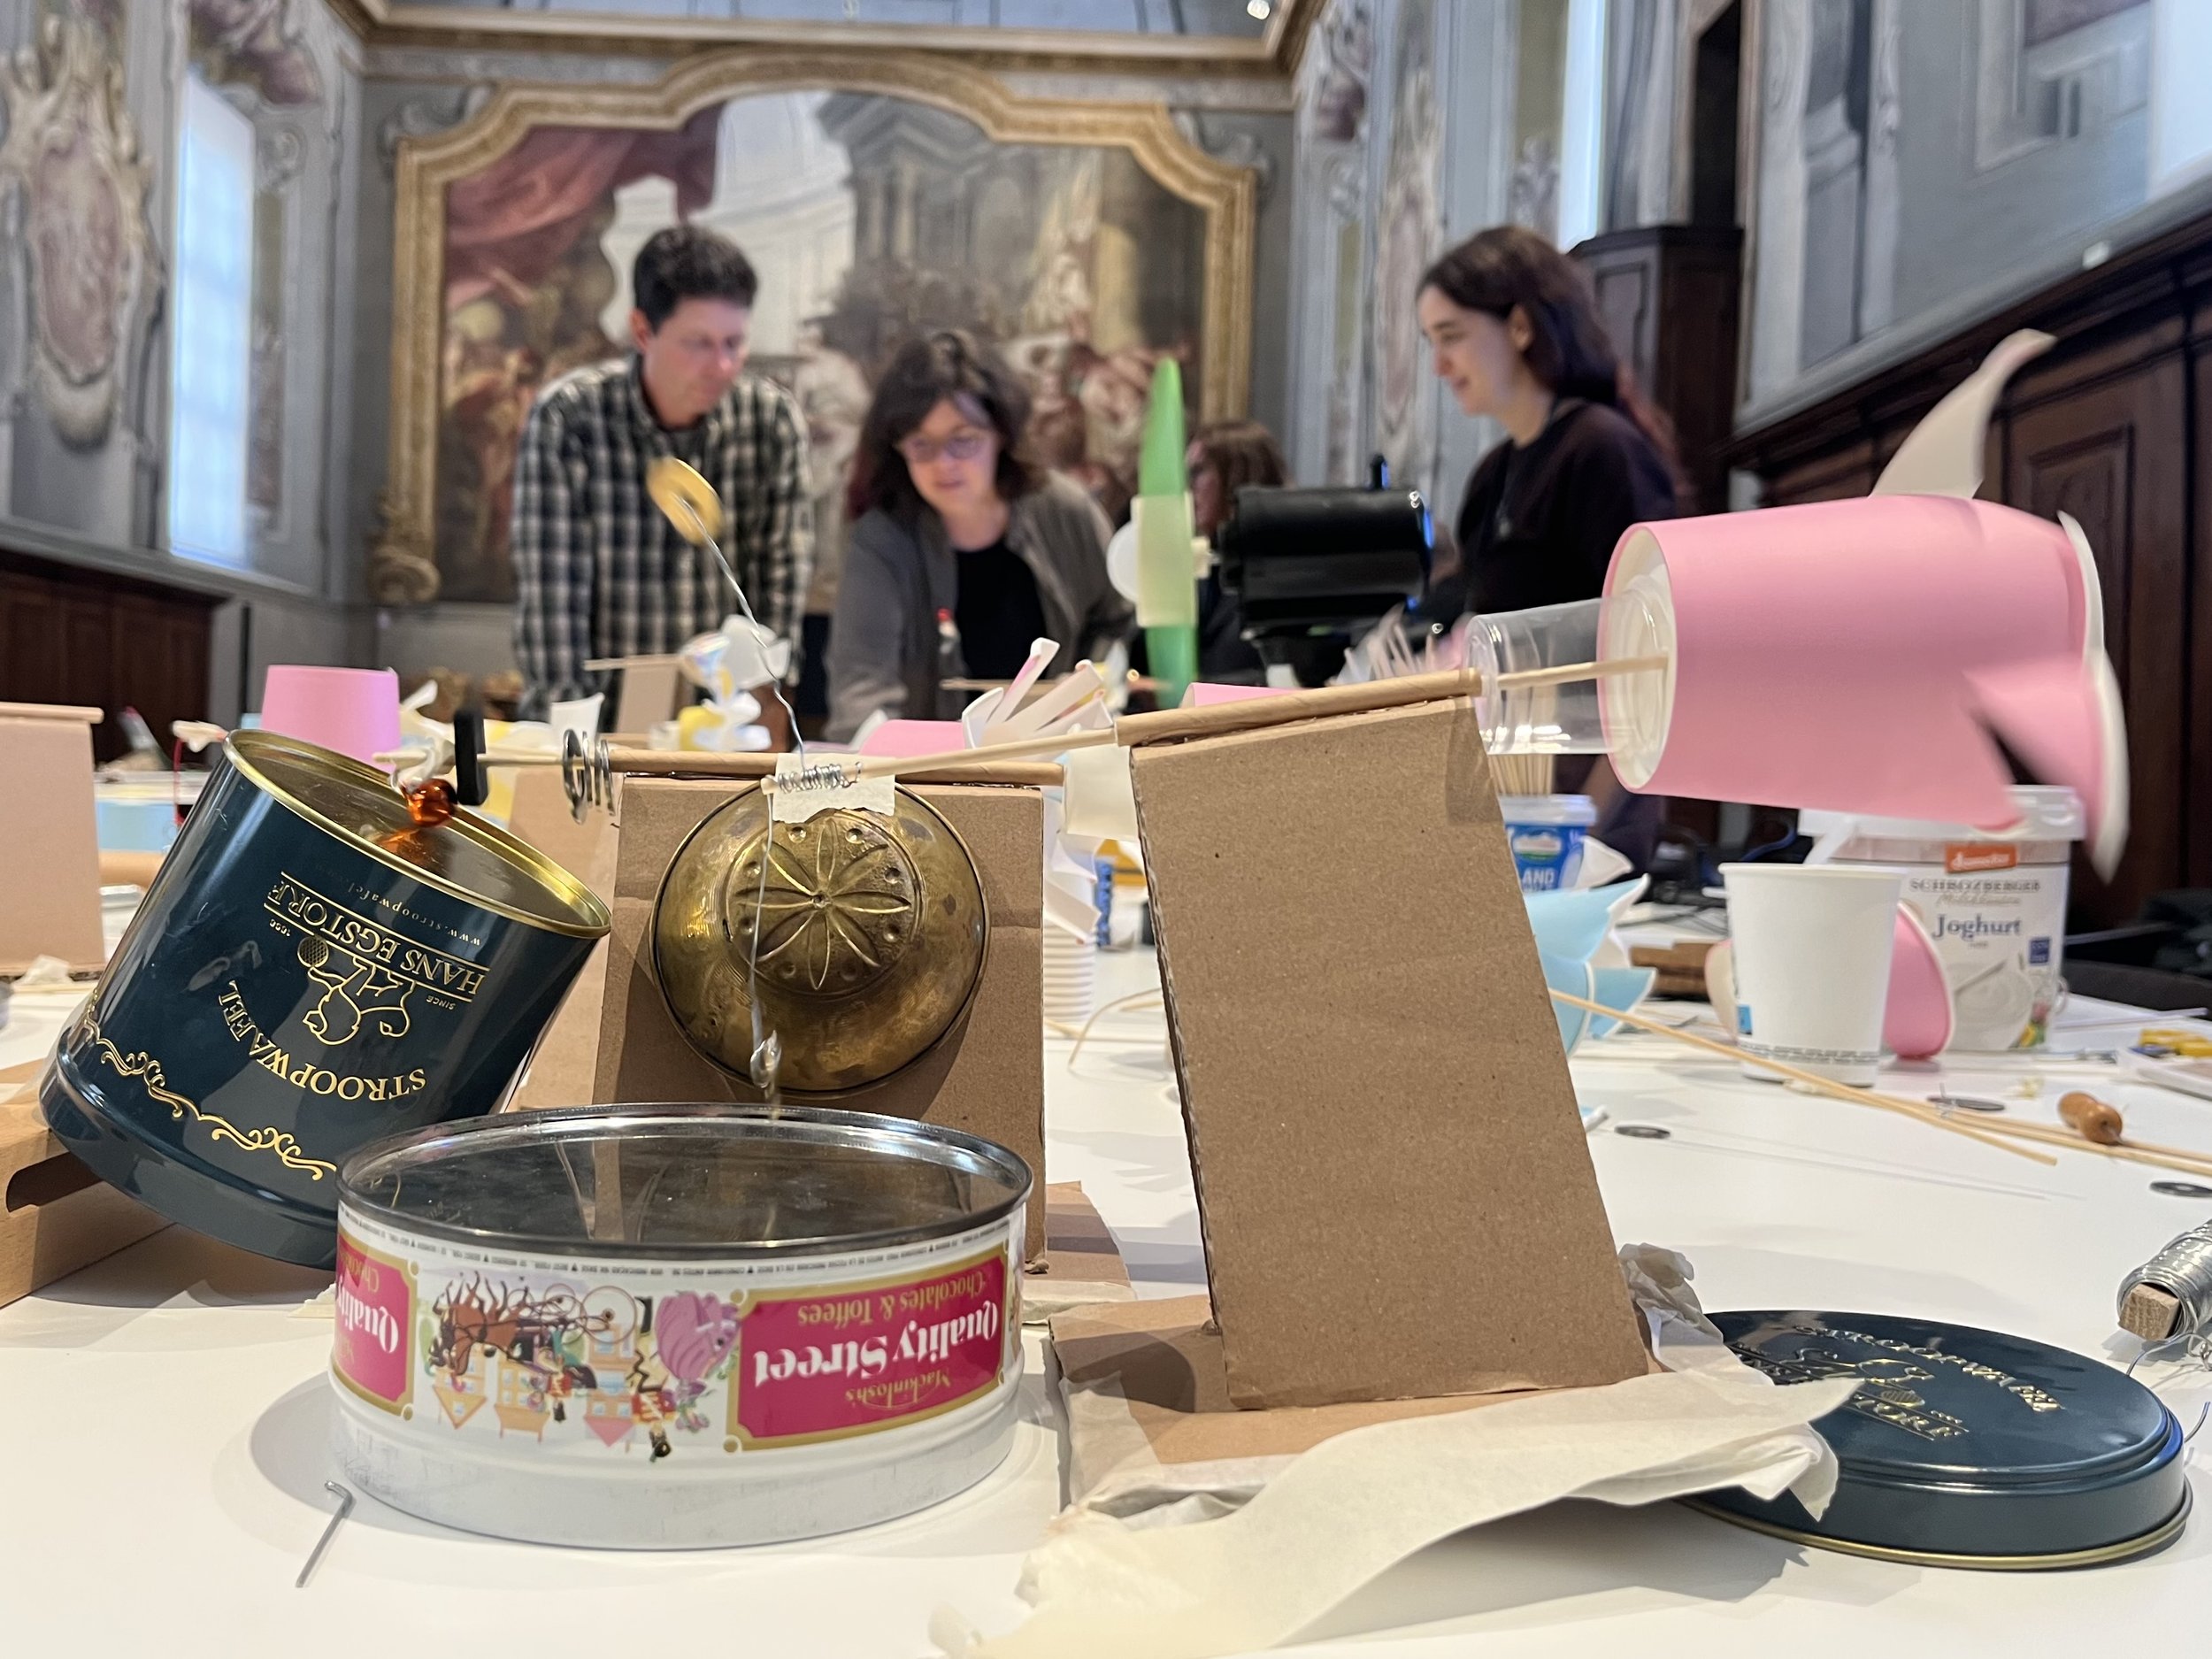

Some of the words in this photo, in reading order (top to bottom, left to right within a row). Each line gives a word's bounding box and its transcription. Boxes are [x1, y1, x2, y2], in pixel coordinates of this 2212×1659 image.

[267, 879, 401, 964] EGSTORF
[1932, 913, 2023, 941] Joghurt
[400, 949, 487, 995] HANS
[426, 995, 457, 1010] SINCE
[219, 979, 426, 1102] STROOPWAFEL
[879, 1299, 895, 1318] &
[900, 1270, 987, 1311] Chocolates
[798, 1298, 874, 1330] Toffees
[892, 1300, 999, 1363] Quality
[753, 1335, 887, 1388] Street
[845, 1367, 952, 1409] Mackintosh's
